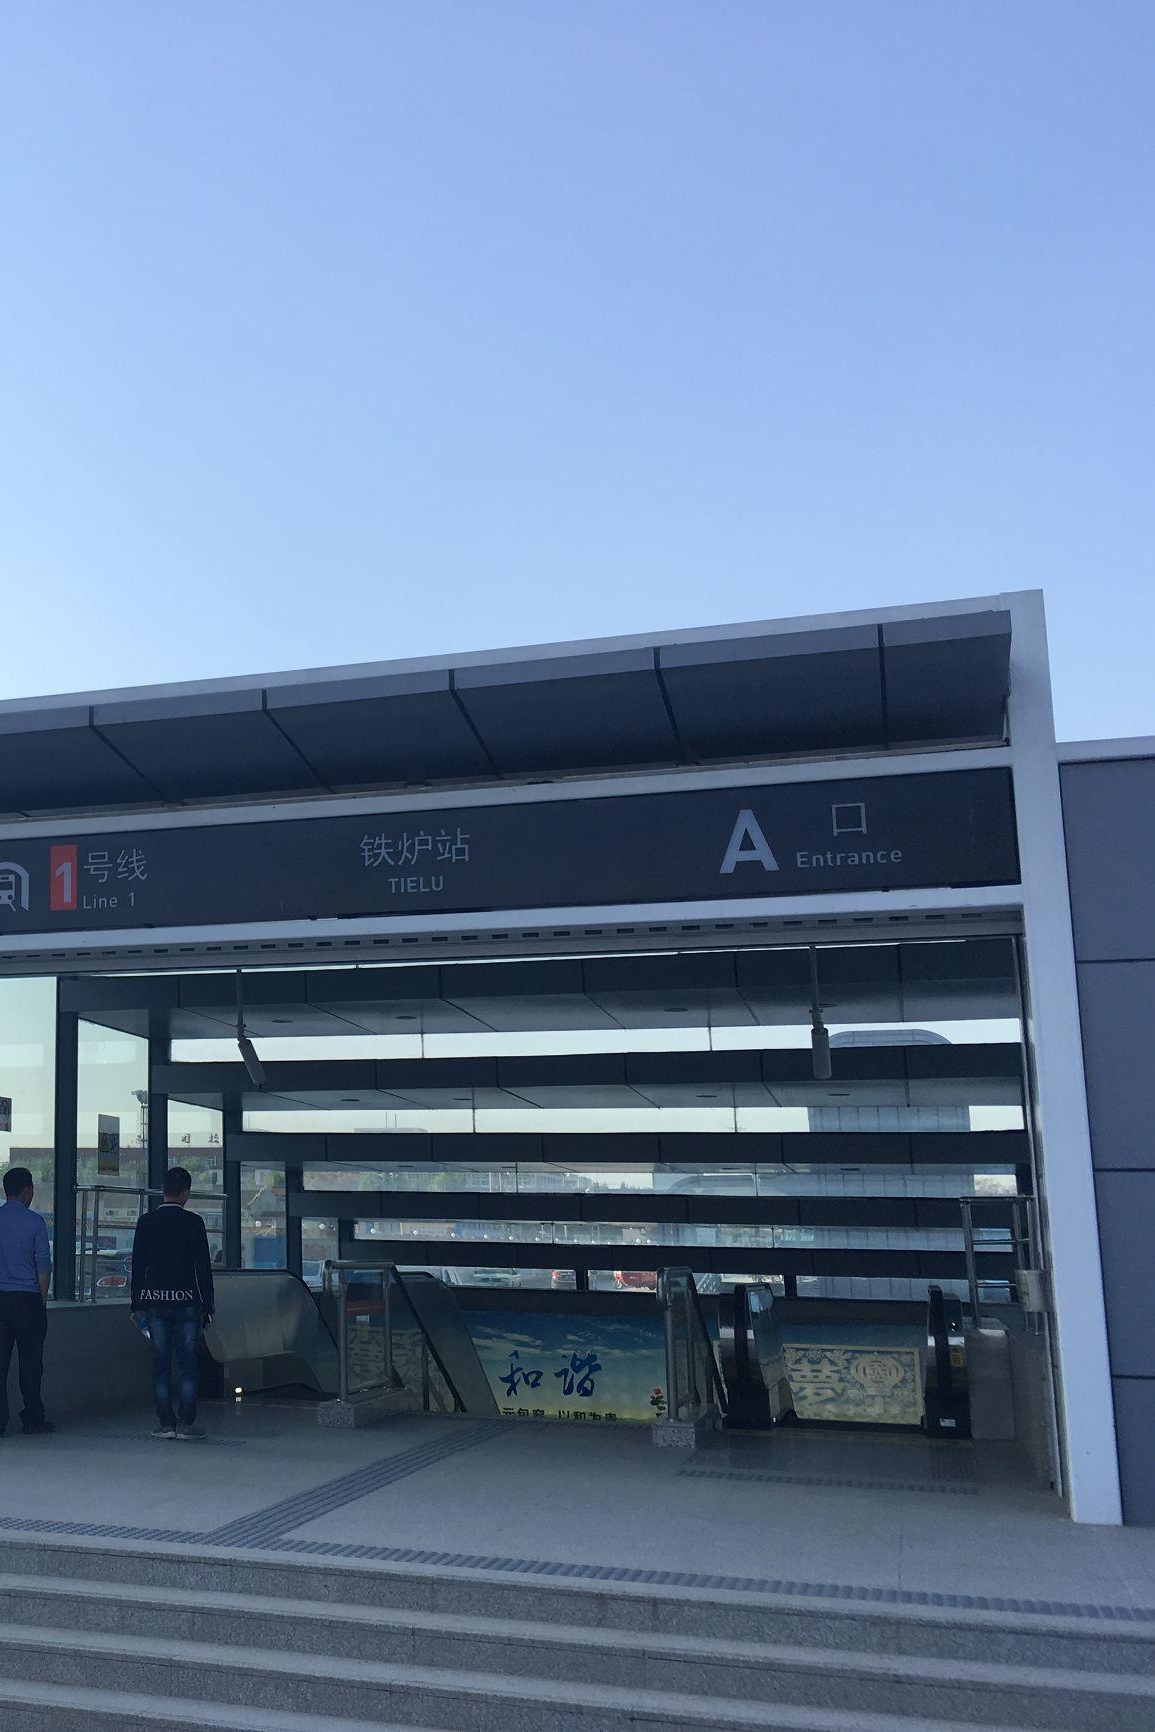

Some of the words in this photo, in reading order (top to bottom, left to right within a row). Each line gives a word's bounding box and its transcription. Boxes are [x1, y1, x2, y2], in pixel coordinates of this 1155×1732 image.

[831, 802, 868, 836] 口
[359, 827, 471, 867] 铁炉站
[719, 809, 780, 874] A
[55, 862, 72, 903] 1
[83, 848, 147, 883] 号线
[795, 849, 903, 869] Entrance
[83, 894, 118, 909] Line
[127, 892, 134, 907] 1
[387, 875, 444, 894] TIELU
[140, 1289, 193, 1301] FASHION
[498, 1349, 602, 1397] 和谐
